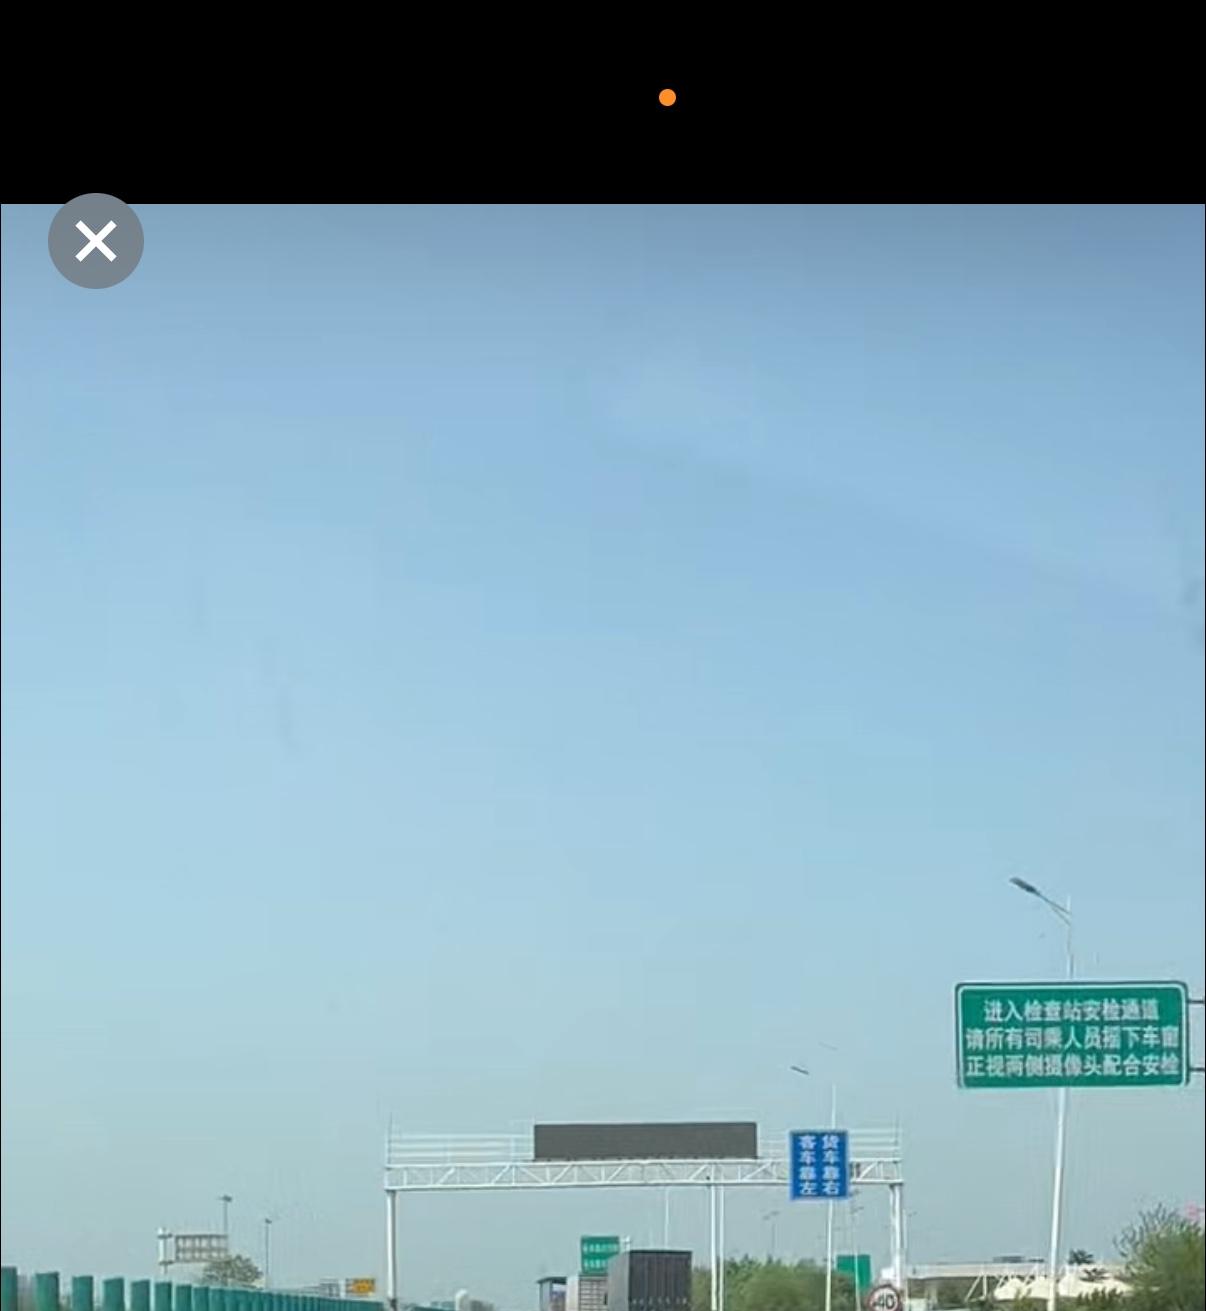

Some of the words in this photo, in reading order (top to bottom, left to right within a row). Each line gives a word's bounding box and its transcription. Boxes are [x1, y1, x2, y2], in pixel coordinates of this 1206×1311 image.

[984, 998, 1159, 1022] 进入检查站安检通道
[966, 1026, 1179, 1050] 请所有司乘人员摇下车窗
[966, 1053, 1179, 1077] 正视两侧摄像头配合安检
[799, 1135, 817, 1195] 客车靠左
[821, 1134, 840, 1195] 货车靠右
